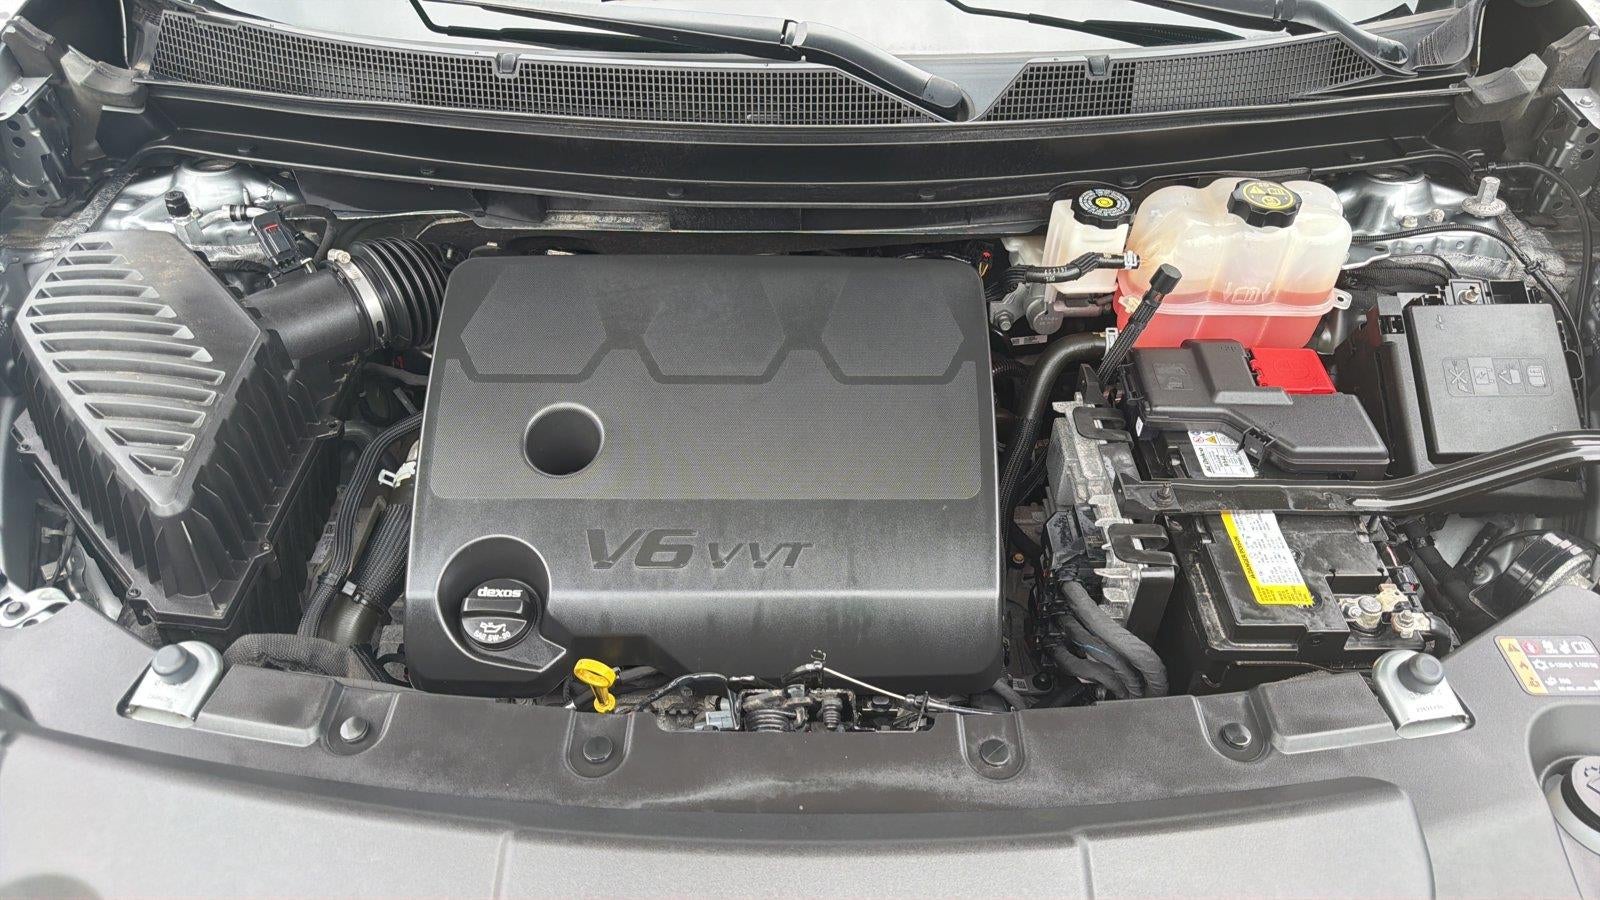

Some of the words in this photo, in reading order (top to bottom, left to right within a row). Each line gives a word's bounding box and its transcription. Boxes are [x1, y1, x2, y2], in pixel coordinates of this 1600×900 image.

[586, 528, 699, 569] V6
[708, 542, 814, 569] VVT
[477, 586, 523, 597] dexos
[473, 630, 487, 641] SAE
